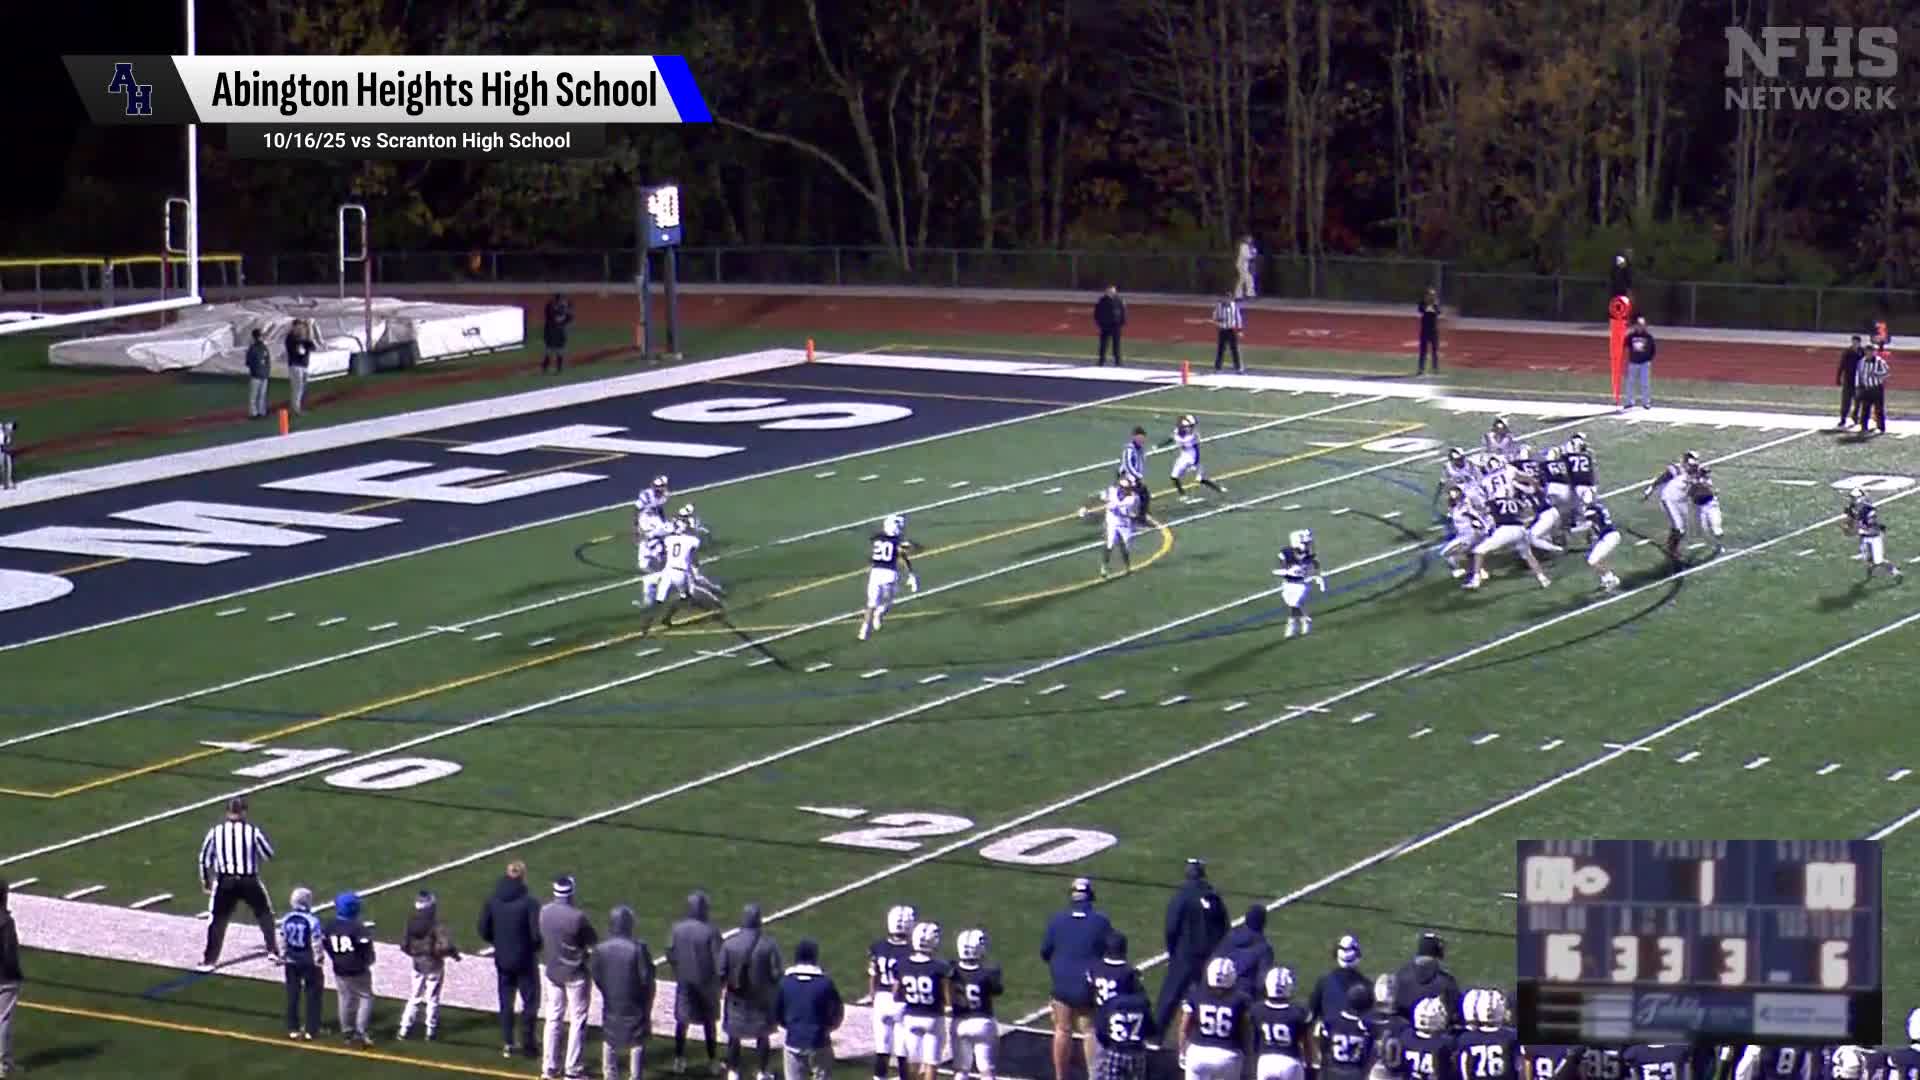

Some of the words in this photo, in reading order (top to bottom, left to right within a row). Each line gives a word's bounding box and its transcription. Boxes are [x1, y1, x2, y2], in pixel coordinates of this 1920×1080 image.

[1568, 456, 1590, 472] 72
[1495, 499, 1518, 516] 70
[871, 542, 893, 562] 20
[1199, 1003, 1232, 1038] 56
[1470, 1045, 1504, 1077] 76
